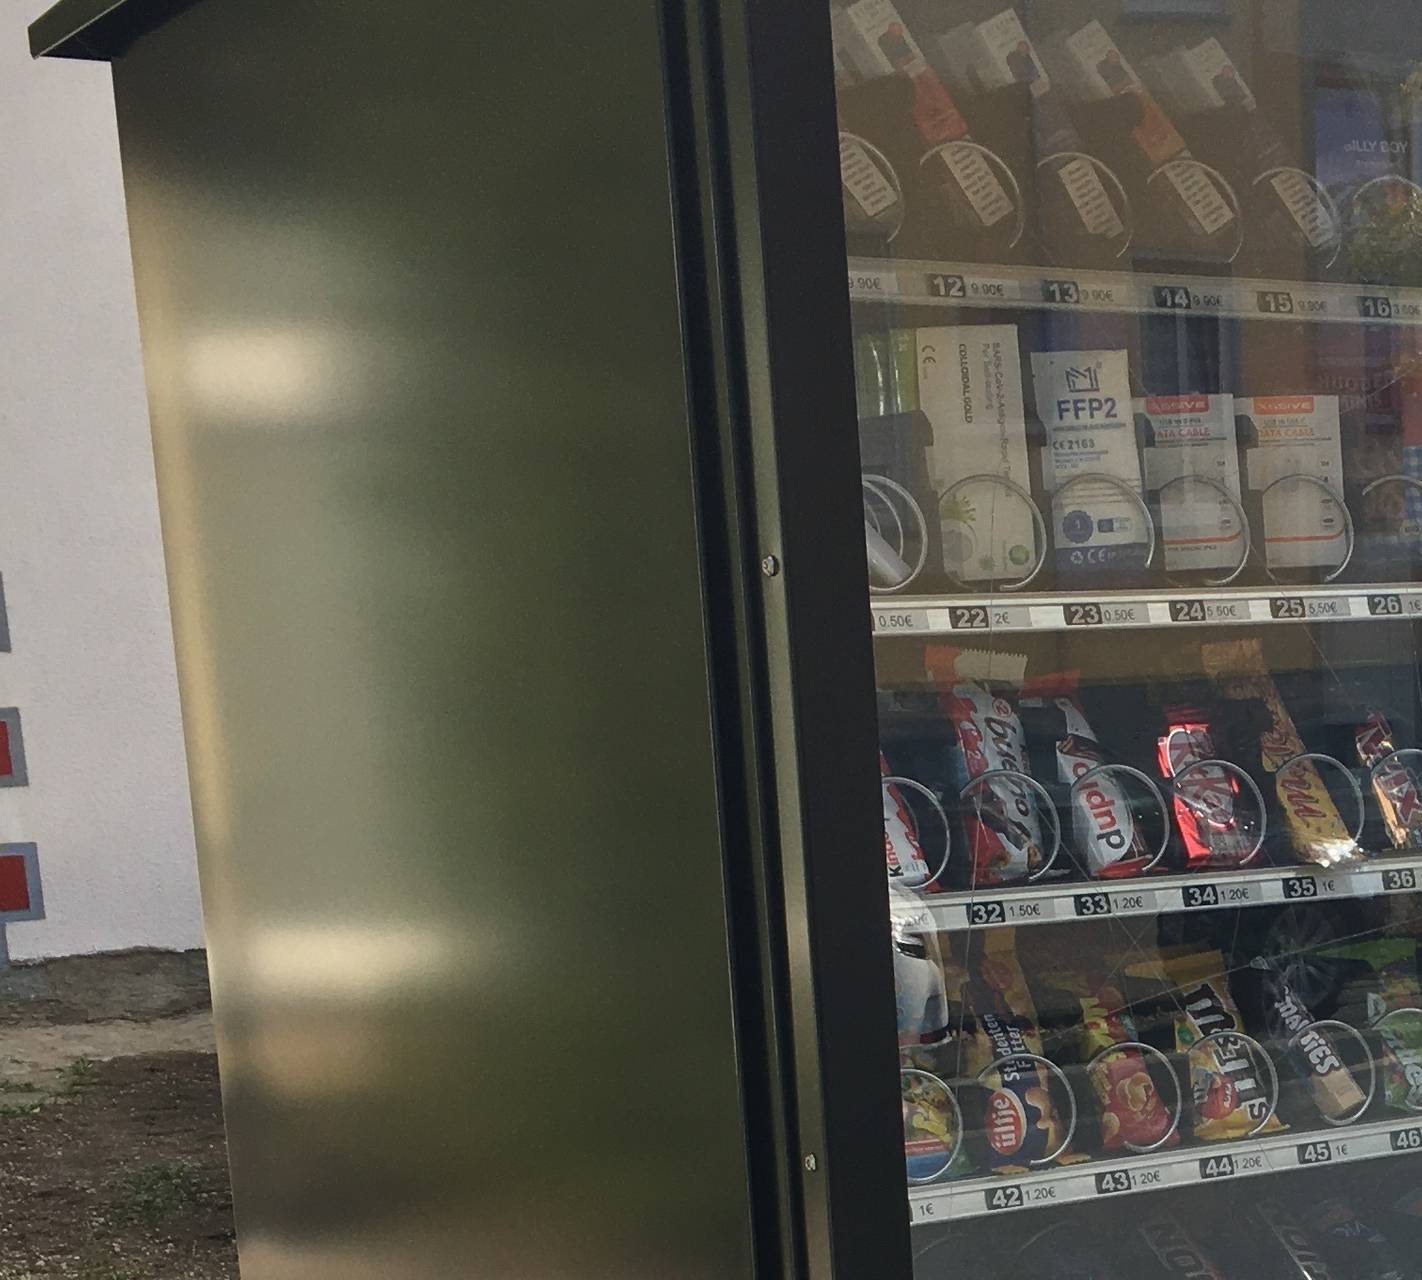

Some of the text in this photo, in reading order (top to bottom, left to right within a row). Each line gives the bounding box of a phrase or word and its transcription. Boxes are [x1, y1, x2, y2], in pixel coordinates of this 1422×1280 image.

[933, 275, 965, 298] 12
[1050, 282, 1079, 302] 13
[1161, 288, 1191, 308] 14
[1265, 293, 1293, 313] 15
[1365, 299, 1391, 317] 16
[1057, 397, 1118, 421] FFP2
[1070, 605, 1136, 624] 23 0.50€
[1176, 602, 1203, 621] 24
[1277, 599, 1303, 617] 25
[1374, 596, 1422, 614] 26 1€
[878, 614, 913, 628] 0.50€
[955, 608, 1010, 628] 22 2€
[1072, 761, 1126, 850] duplo
[1288, 879, 1335, 897] 35 1€
[1388, 870, 1414, 888] 36
[1080, 894, 1143, 915] 33 1.20€
[1188, 886, 1250, 905] 34 1.20€
[973, 902, 1041, 923] 32 1.50€
[992, 1097, 1018, 1149] ültje
[1395, 1130, 1422, 1148] 46
[1303, 1143, 1348, 1162] 45 1€
[1205, 1156, 1263, 1176] 44 1.20€
[1101, 1172, 1161, 1191] 43 1.20€
[991, 1186, 1056, 1208] 42 1.20€
[918, 1203, 934, 1217] 1€
